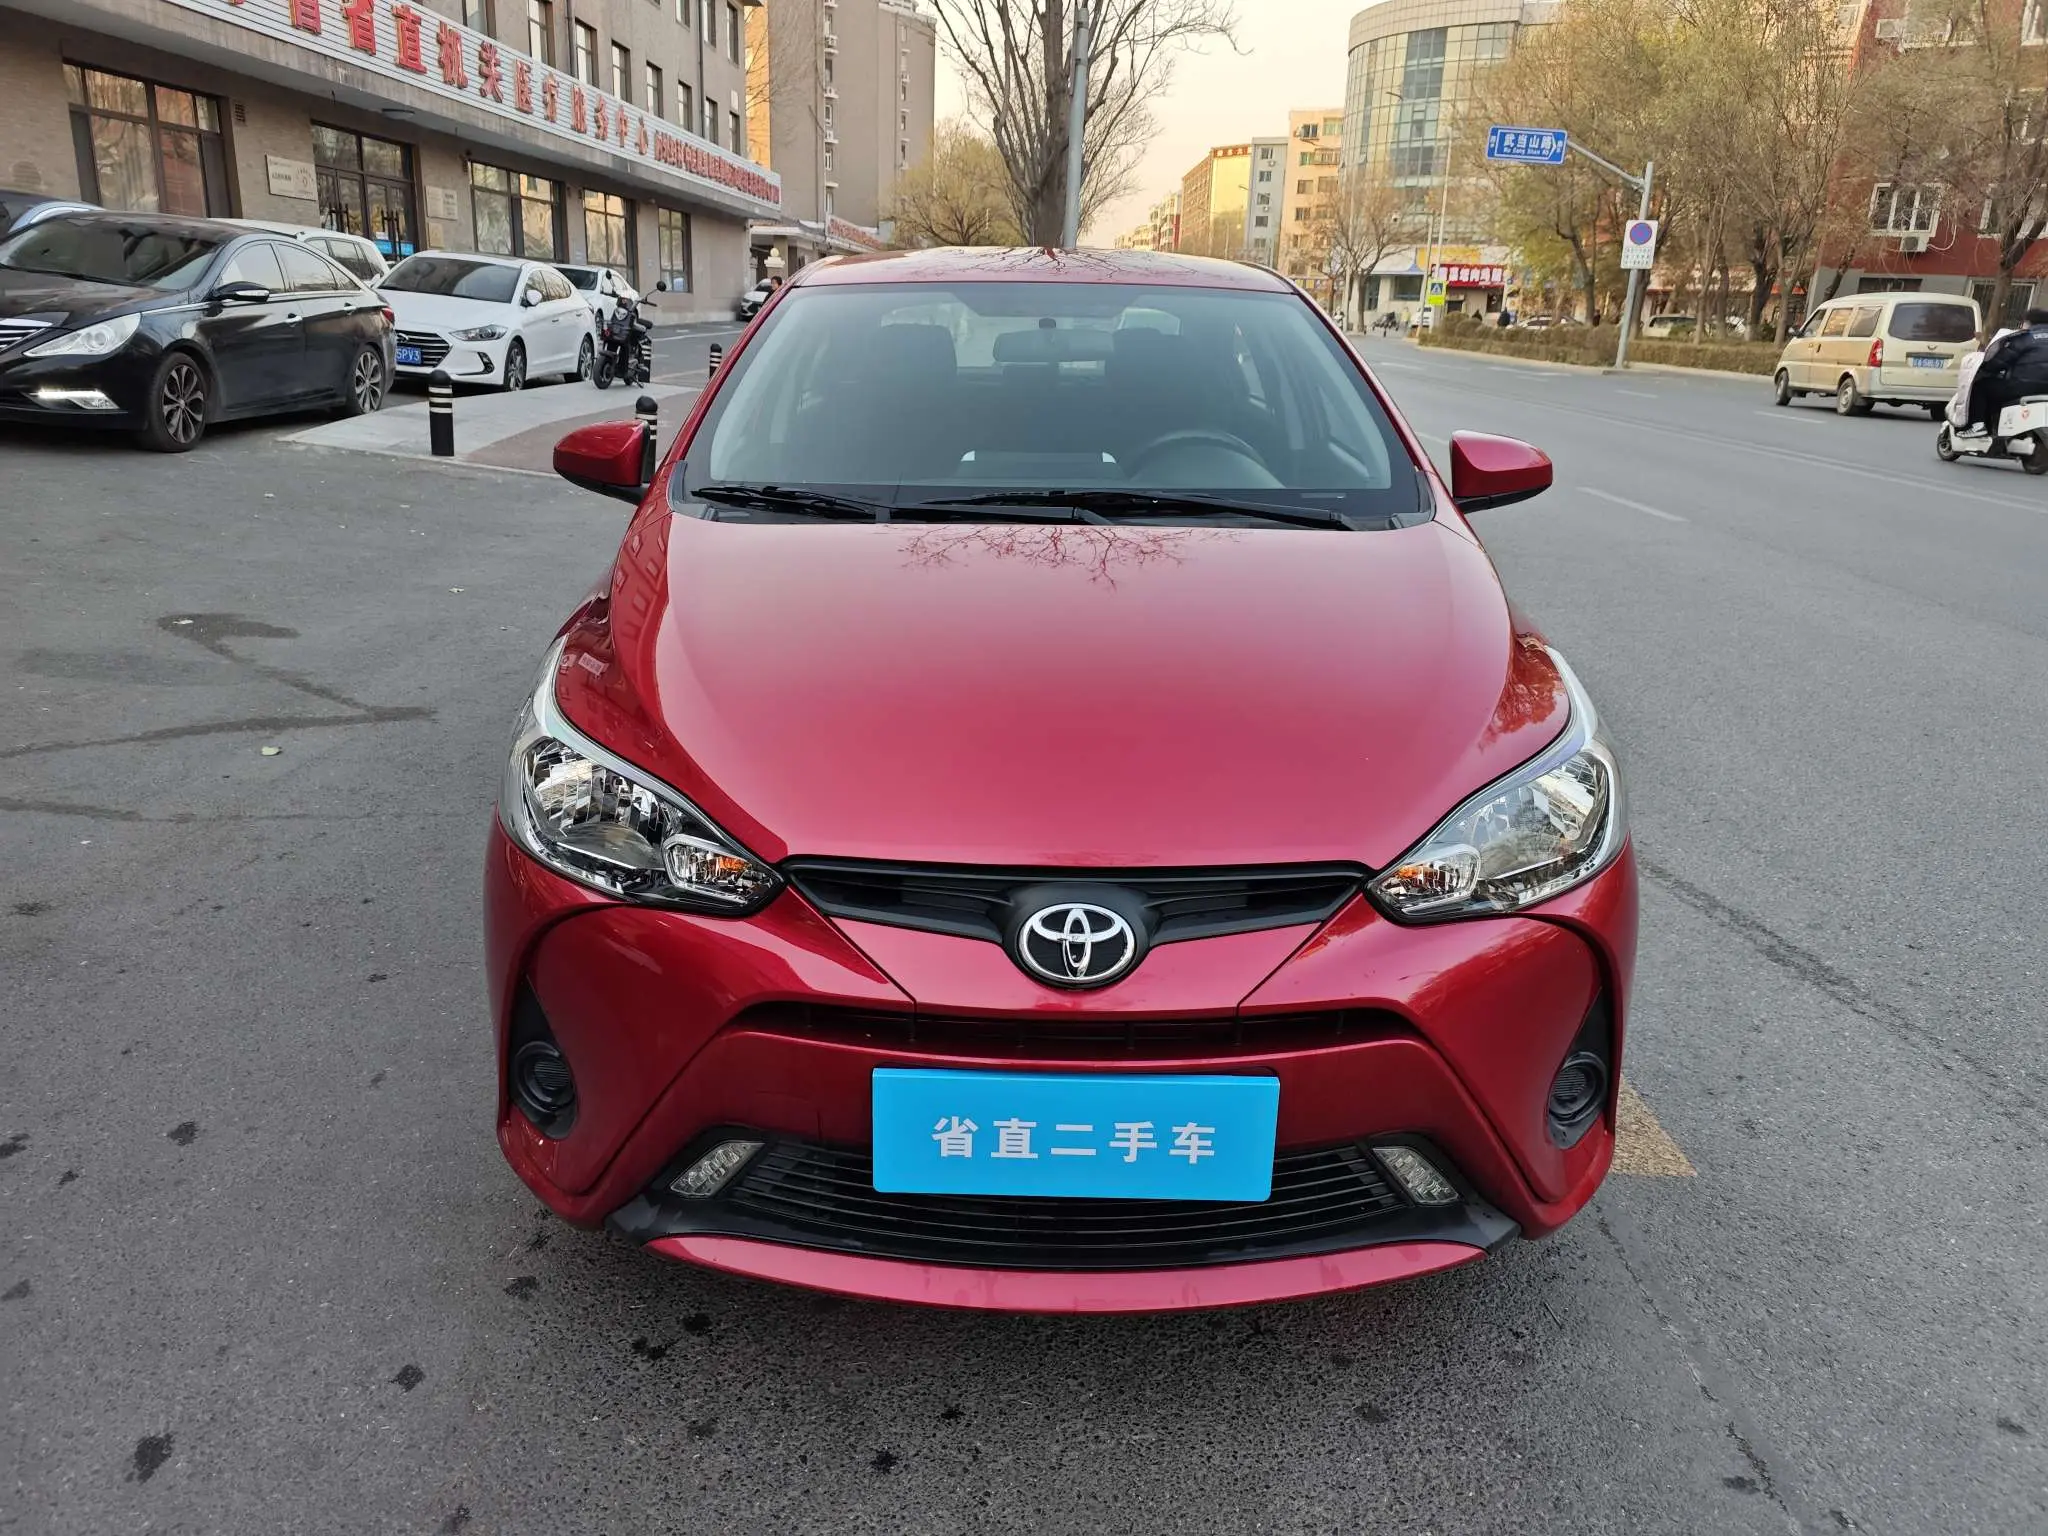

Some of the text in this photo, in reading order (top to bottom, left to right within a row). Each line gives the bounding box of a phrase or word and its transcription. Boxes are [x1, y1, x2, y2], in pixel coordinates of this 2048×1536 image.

[931, 1115, 1217, 1165] 省直二手车
